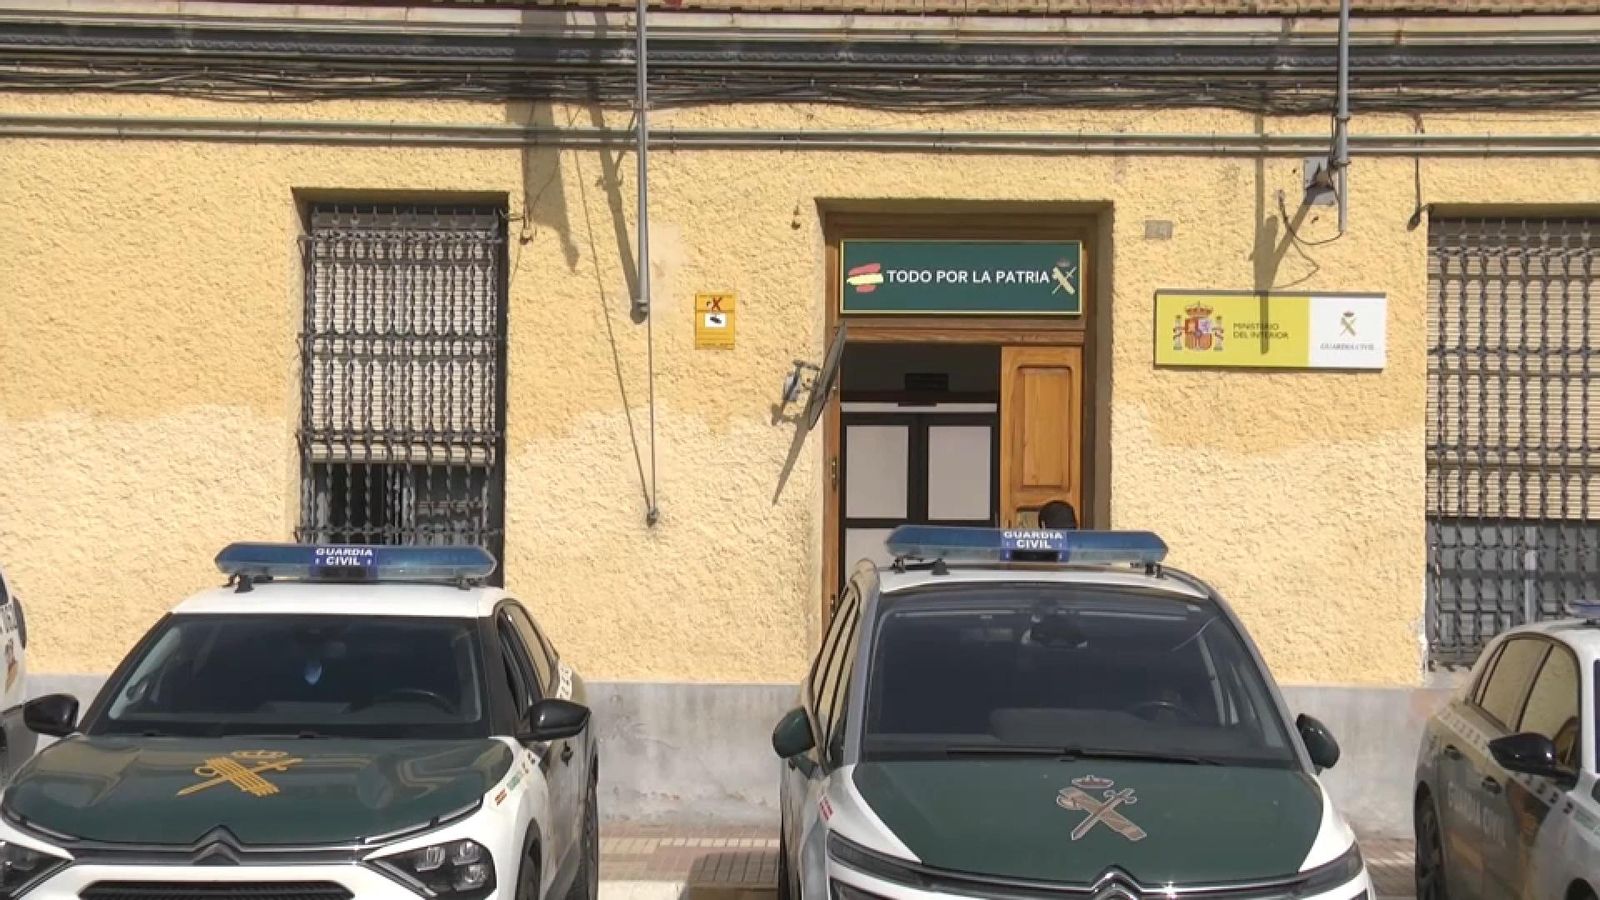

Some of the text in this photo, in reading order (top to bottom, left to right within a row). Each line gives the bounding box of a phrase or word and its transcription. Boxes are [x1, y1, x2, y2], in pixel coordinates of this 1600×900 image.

[886, 269, 1051, 285] TODO POR LA PATRIA
[1233, 322, 1280, 332] MINISTERIO
[1233, 331, 1289, 341] DEL INTERIOR
[1003, 530, 1064, 540] GUARDIA
[1016, 539, 1052, 549] CIVIL
[315, 547, 373, 556] GUARDIA
[325, 556, 361, 566] CIVIL
